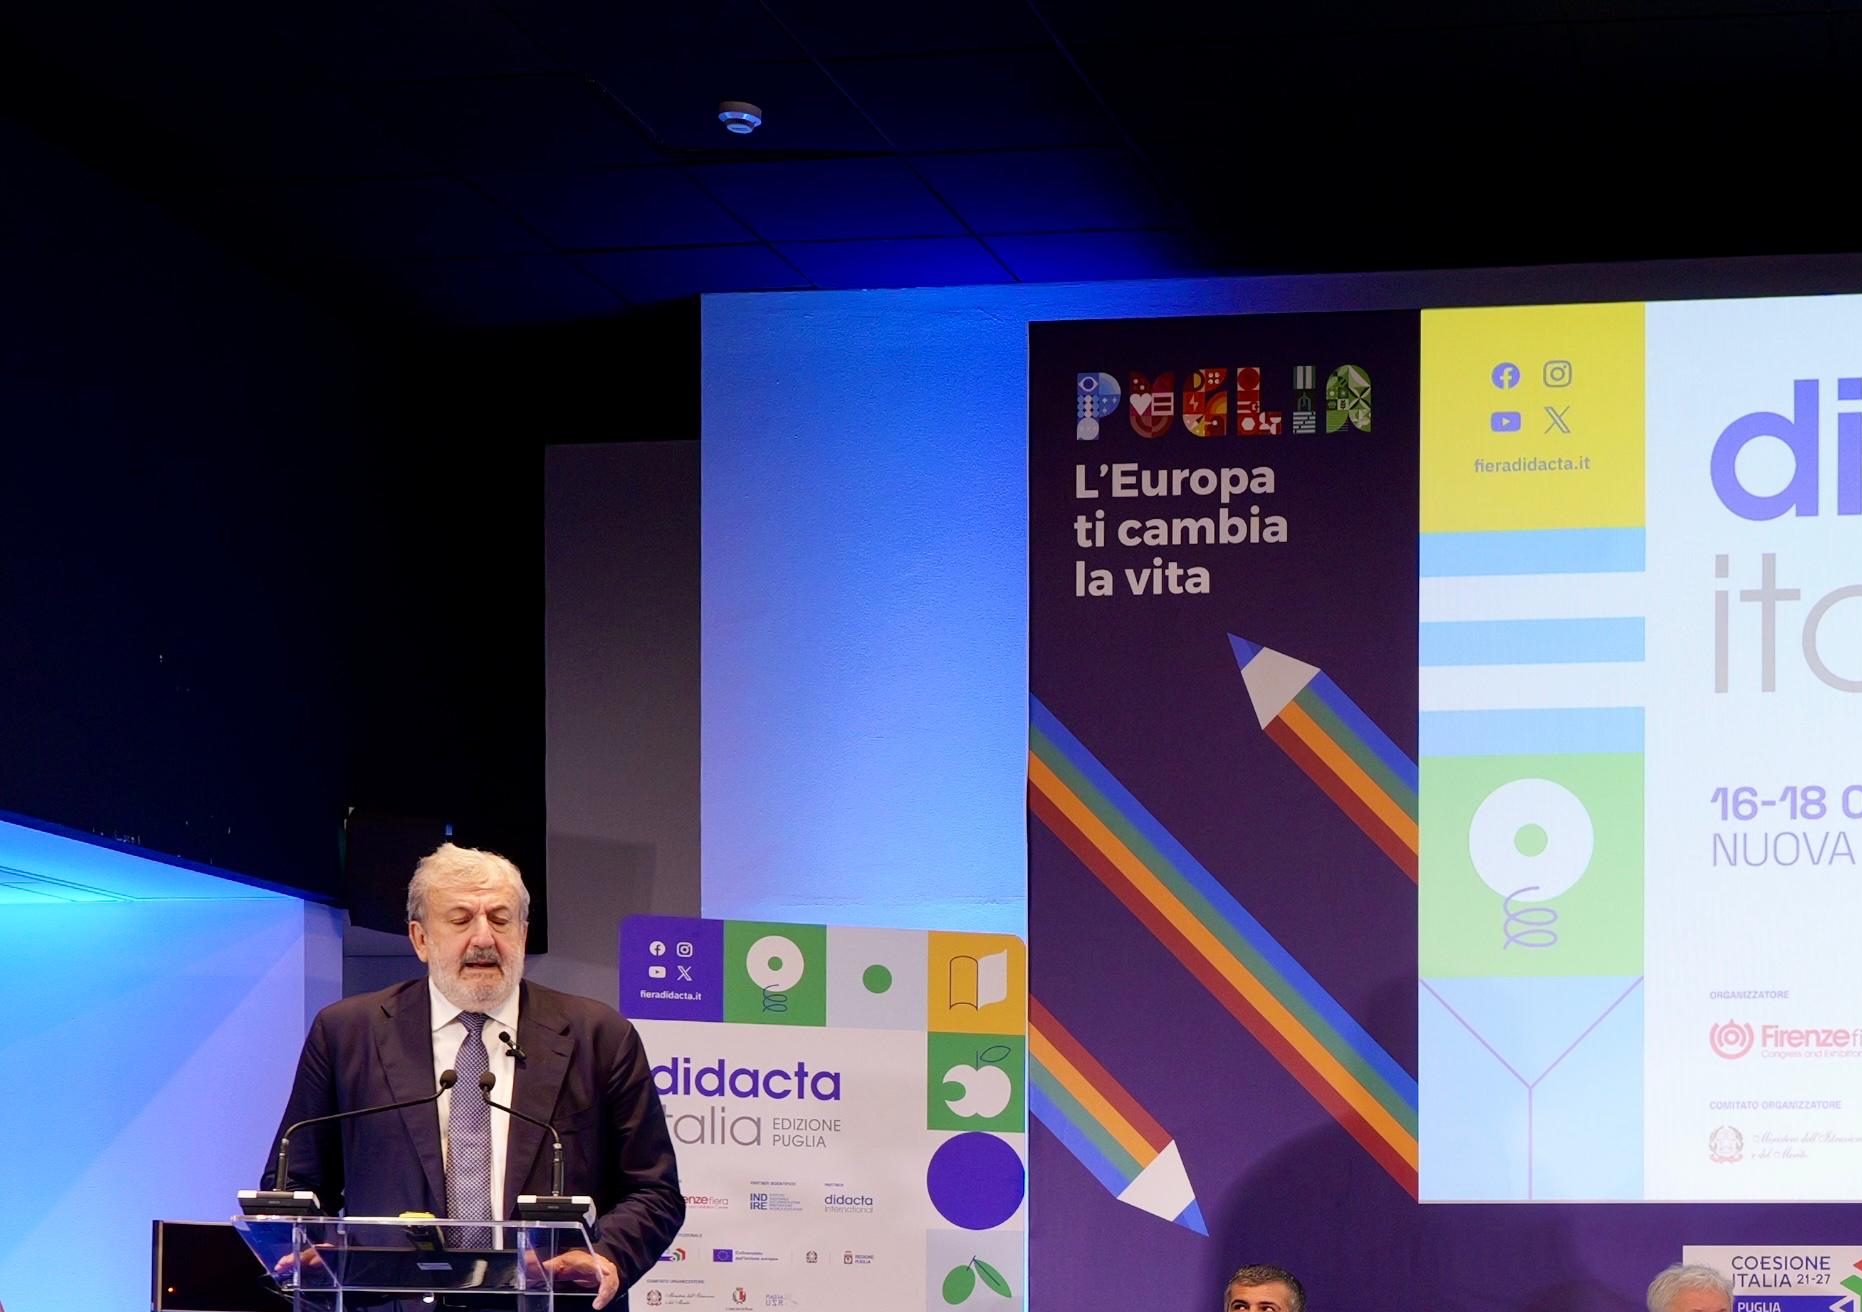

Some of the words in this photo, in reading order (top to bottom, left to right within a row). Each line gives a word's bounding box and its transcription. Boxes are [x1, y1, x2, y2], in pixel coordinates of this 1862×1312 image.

[1076, 363, 1373, 440] PUGLIA
[1474, 456, 1591, 473] fieradidacta.it
[1074, 462, 1276, 503] L'Europa
[1074, 511, 1105, 548] ti
[1117, 507, 1288, 547] cambia
[1075, 560, 1114, 597] la
[1126, 557, 1211, 595] vita
[1710, 785, 1828, 822] 16-18
[1711, 830, 1856, 867] NUOVA
[640, 989, 702, 1001] fieradidacta.it
[651, 1057, 841, 1101] didacta
[773, 1118, 841, 1132] EDIZIONE
[773, 1134, 826, 1148] PUGLIA
[824, 1194, 873, 1205] didacta
[1731, 1255, 1831, 1271] COESIONE
[1732, 1273, 1793, 1288] ITALIA
[1796, 1273, 1831, 1285] 21-27
[1737, 1301, 1782, 1312] PUGLIA
